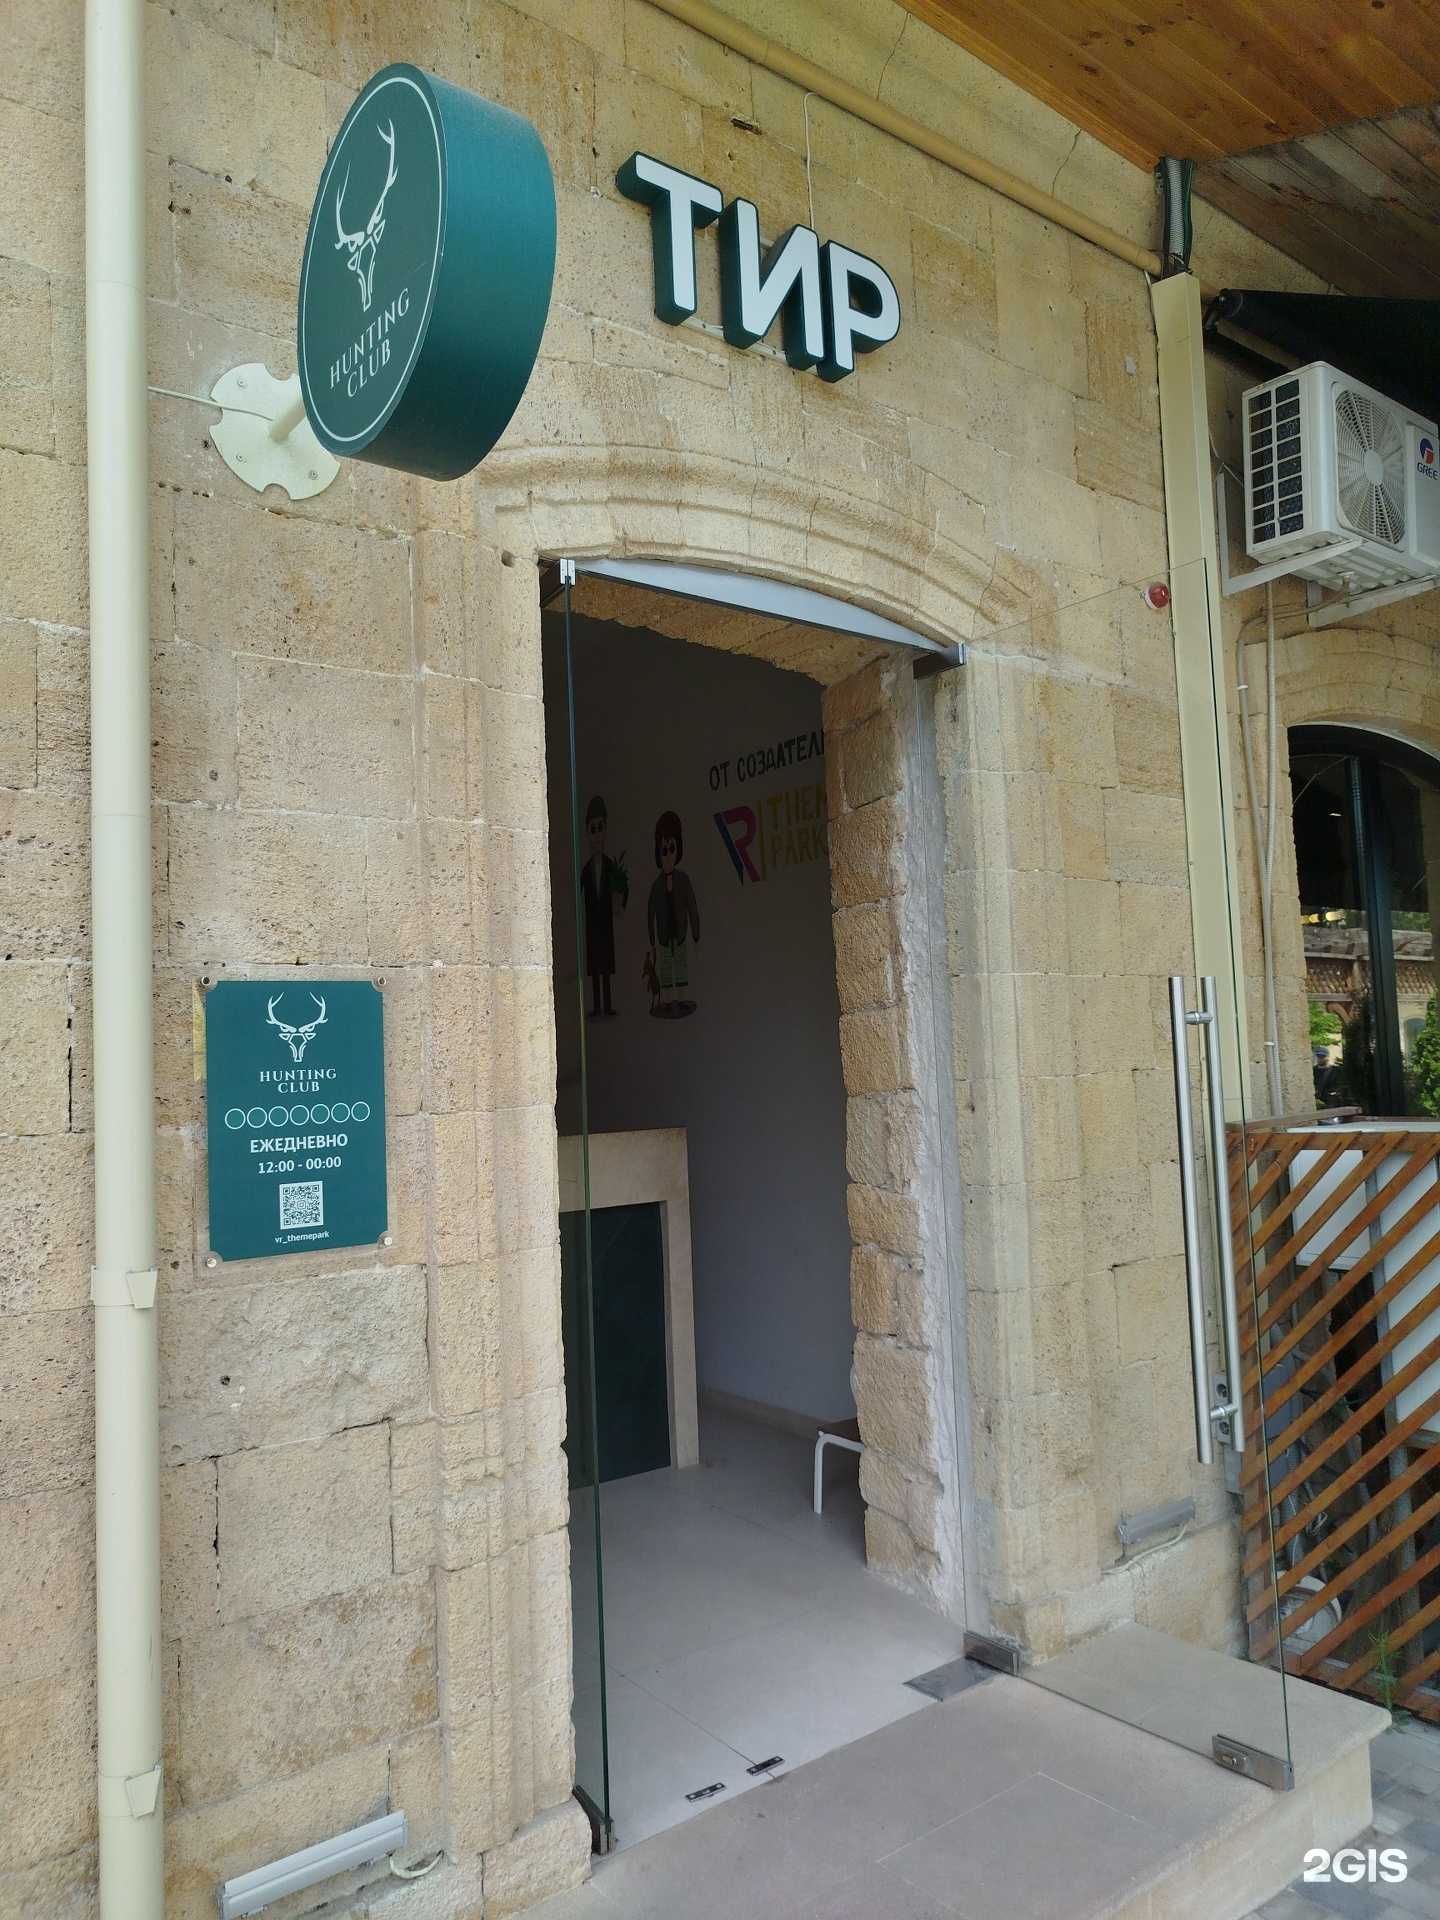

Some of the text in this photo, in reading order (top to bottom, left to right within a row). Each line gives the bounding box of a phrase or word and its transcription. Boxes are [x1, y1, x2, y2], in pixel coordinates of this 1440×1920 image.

[628, 151, 900, 375] ТИР
[329, 287, 411, 390] HUNTING
[346, 337, 392, 399] CLUB
[1416, 462, 1439, 481] GREE
[708, 760, 731, 791] ОТ
[259, 1068, 338, 1083] HUNTING
[277, 1081, 321, 1094] CLUB
[249, 1133, 349, 1154] ЕЖЕДНЕВНО
[257, 1160, 295, 1175] 12:00
[305, 1156, 342, 1171] 00:00
[274, 1230, 330, 1244] vr_themepark
